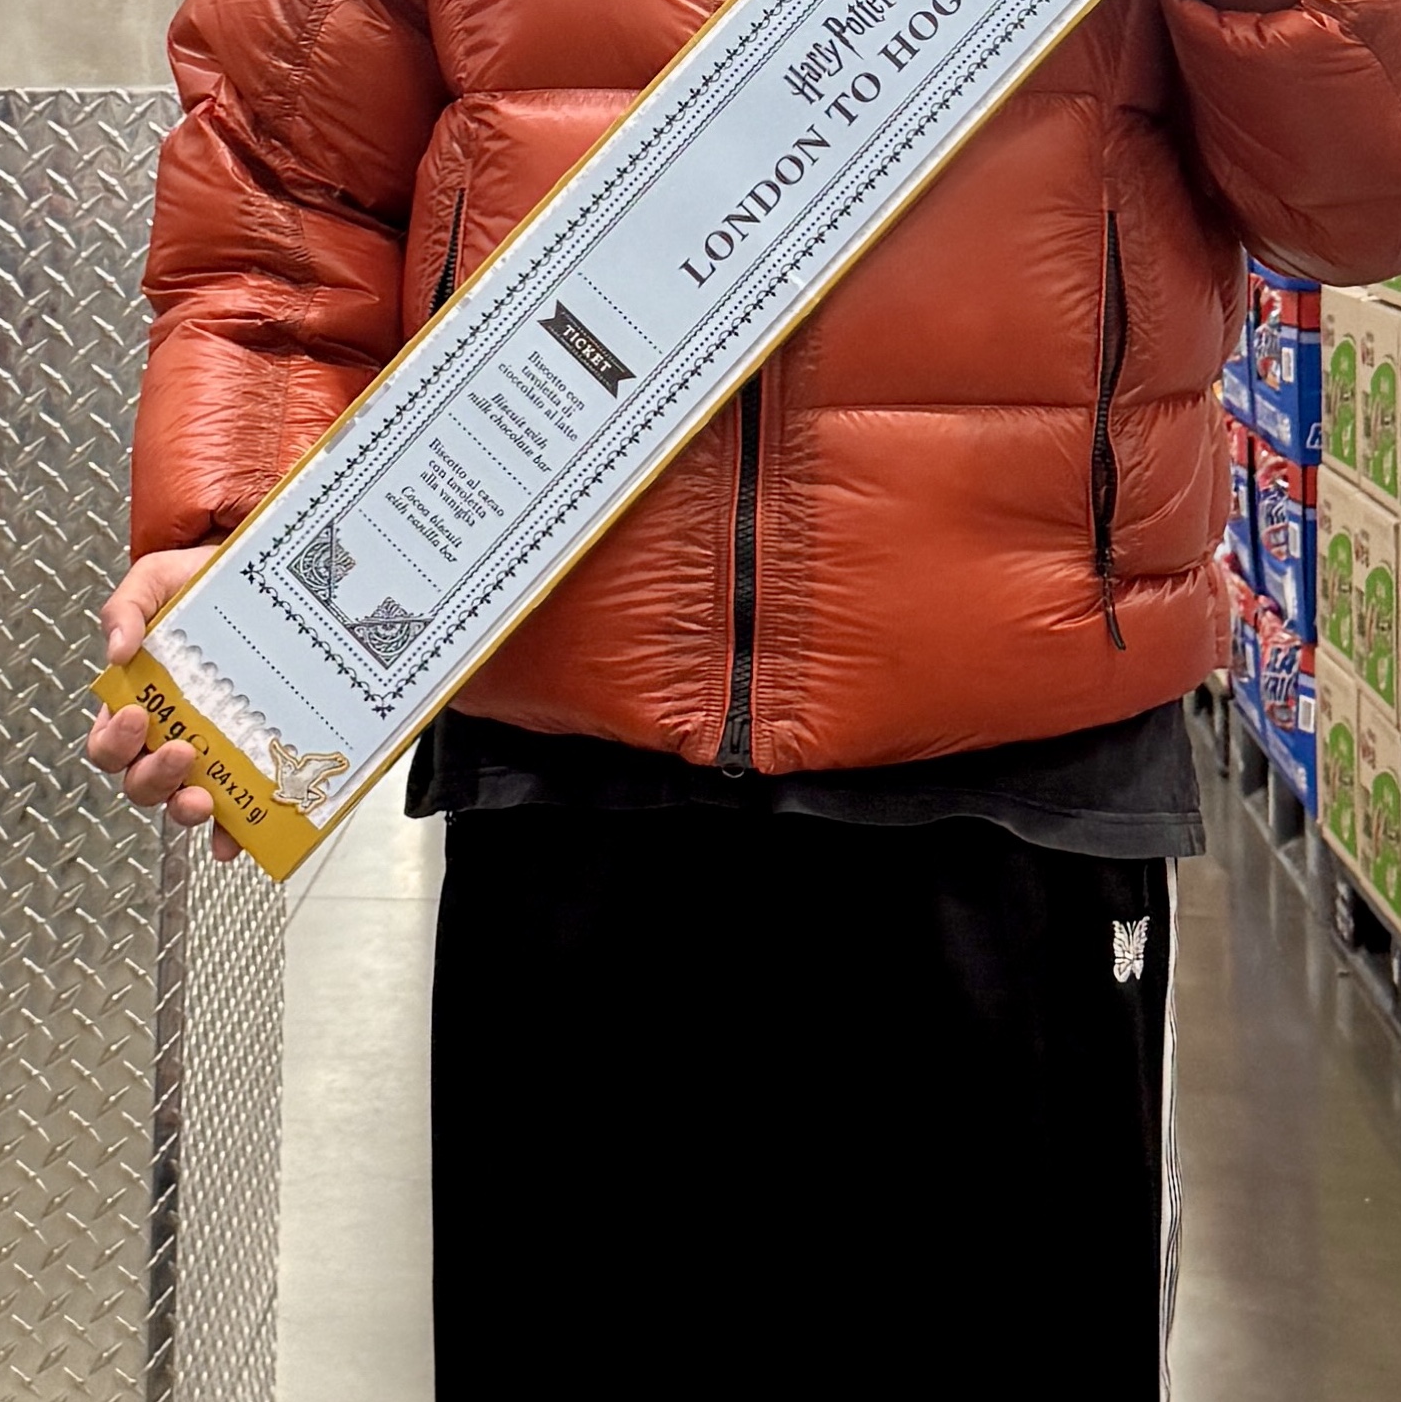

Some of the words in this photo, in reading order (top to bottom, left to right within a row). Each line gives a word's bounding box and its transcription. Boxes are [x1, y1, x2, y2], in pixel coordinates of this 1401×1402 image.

[782, 39, 845, 106] Harry
[679, 124, 832, 288] LONDON
[825, 71, 882, 128] TO
[561, 323, 612, 373] TICKET
[497, 362, 545, 410] cioccolato
[543, 407, 556, 422] al
[554, 418, 579, 442] latte
[521, 365, 562, 408] tavoletta
[561, 403, 577, 419] di
[528, 350, 567, 392] Biscotto
[565, 390, 586, 411] con
[489, 410, 534, 458] chocolate
[532, 453, 553, 474] bar
[524, 425, 548, 450] with
[401, 485, 430, 518] Cocoa
[419, 470, 439, 491] alla
[438, 488, 476, 528] vaniglia
[428, 437, 467, 480] Biscotto
[466, 478, 481, 491] al
[477, 488, 505, 518] cacao
[428, 459, 447, 479] con
[446, 477, 487, 520] tavoletta
[385, 491, 409, 516] with
[406, 514, 441, 548] vanilla
[438, 544, 458, 564] bar
[136, 683, 176, 724] 504
[164, 720, 187, 742] g
[206, 759, 232, 786] (24
[234, 792, 255, 811] 21
[246, 808, 269, 826] g)
